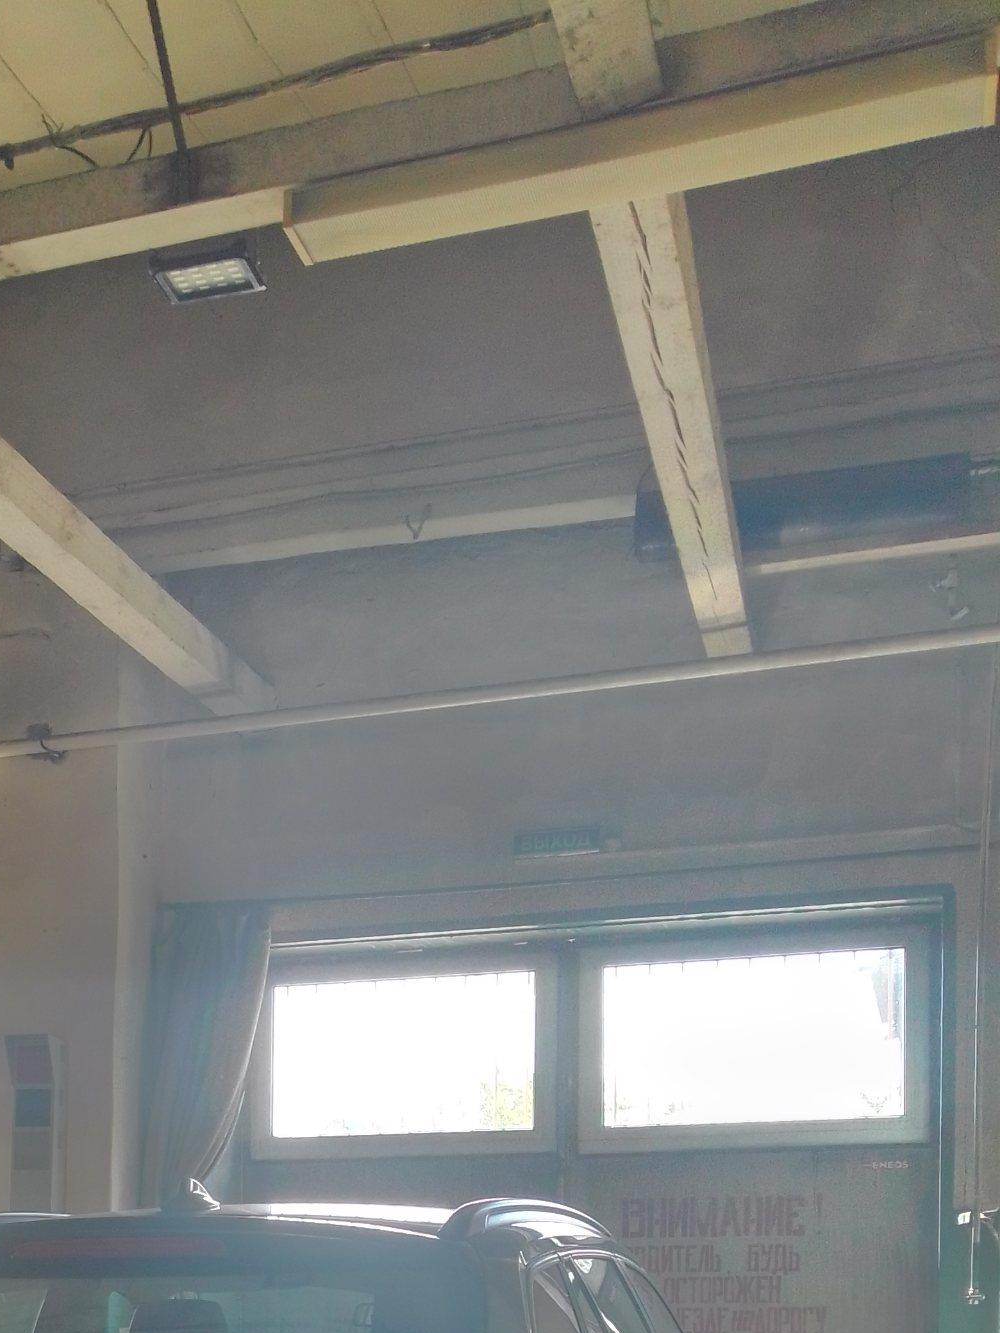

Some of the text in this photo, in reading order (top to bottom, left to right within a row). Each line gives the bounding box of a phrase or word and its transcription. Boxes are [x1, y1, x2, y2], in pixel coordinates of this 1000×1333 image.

[521, 832, 591, 851] ВЫХОД
[620, 1192, 824, 1238] ВНИМАНИЕ!
[747, 1244, 800, 1275] БУДЬ
[664, 1275, 781, 1304] ОСТОРОЖЕН
